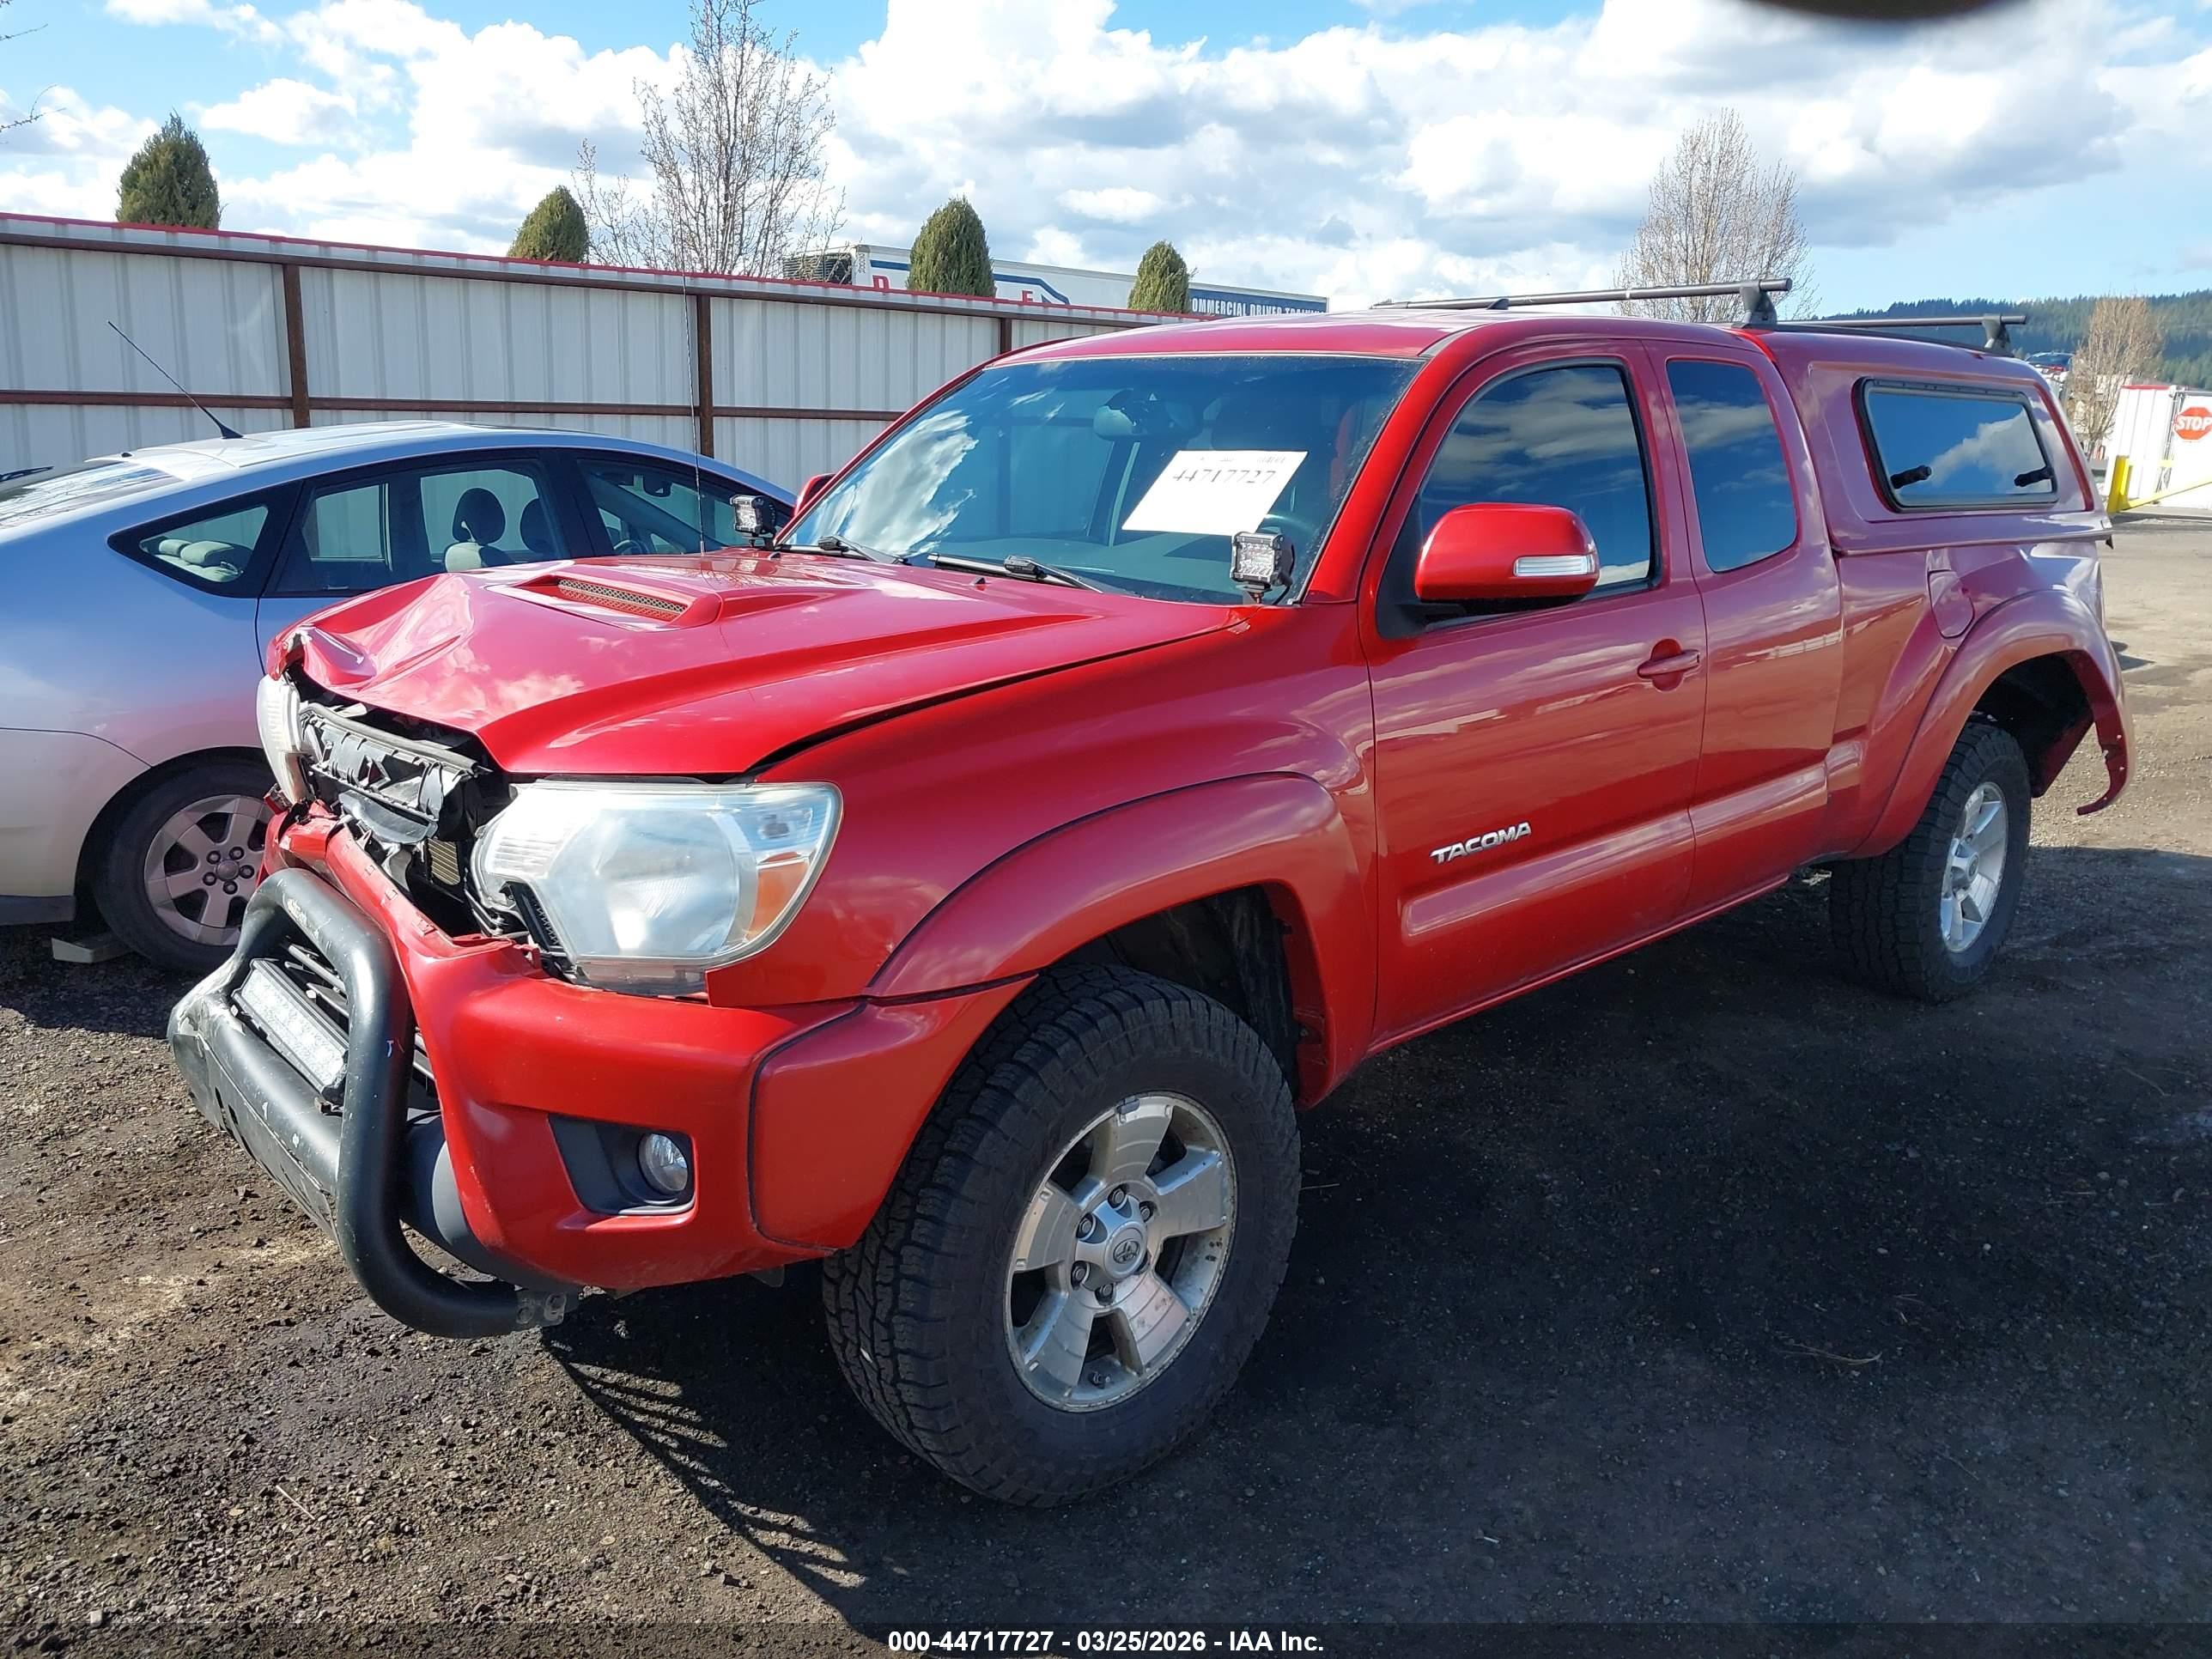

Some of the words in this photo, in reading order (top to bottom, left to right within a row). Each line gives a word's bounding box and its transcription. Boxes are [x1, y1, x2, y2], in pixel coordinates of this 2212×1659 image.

[1189, 298, 1248, 317] OMMERCIAL
[2175, 416, 2212, 431] STOP
[1430, 821, 1532, 865] TACOMA
